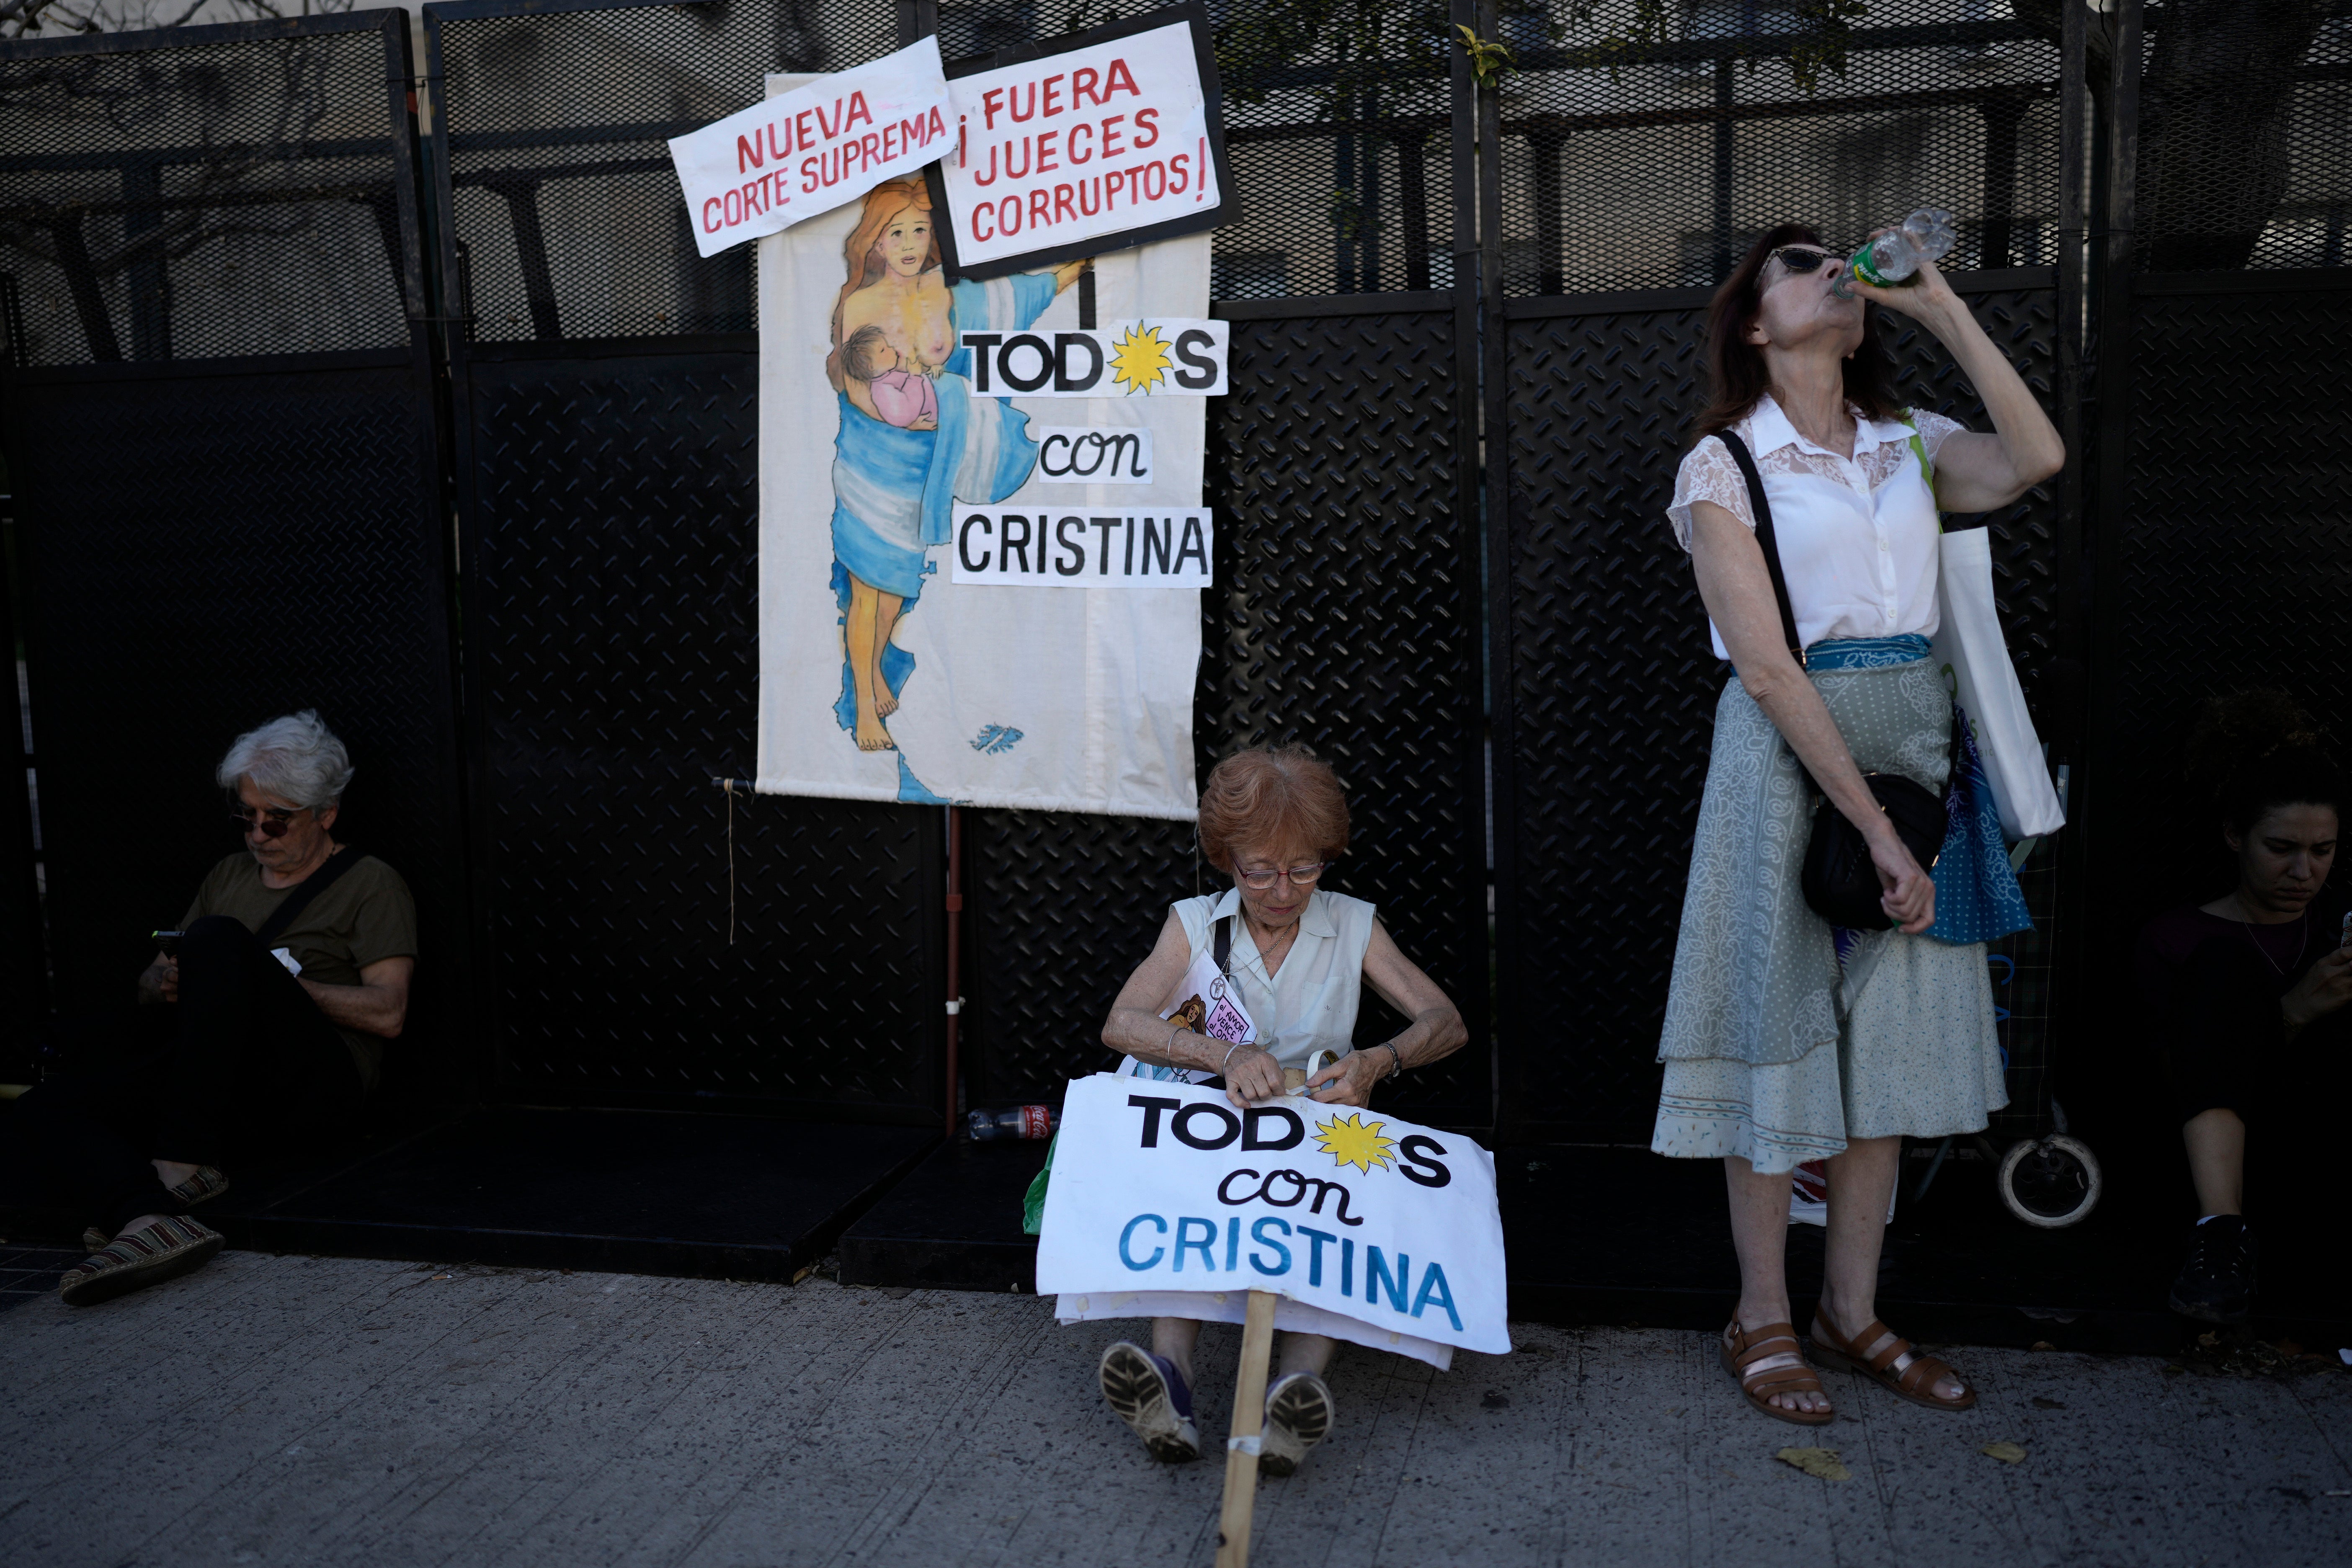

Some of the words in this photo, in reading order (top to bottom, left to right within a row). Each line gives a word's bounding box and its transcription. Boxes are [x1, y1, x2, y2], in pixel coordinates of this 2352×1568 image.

[738, 90, 873, 174] NUEVA
[975, 108, 1159, 187] JUECES
[703, 167, 790, 233] CORTE
[801, 106, 946, 193] SUPREMA
[972, 140, 1205, 242] CORRUPTOS!
[1041, 433, 1147, 476] con
[959, 514, 1207, 575] CRISTINA
[1217, 1014, 1236, 1039] VENCE
[1225, 1011, 1244, 1034] AMOR
[1218, 1169, 1363, 1226] con
[1119, 1213, 1463, 1332] CRISTINA
